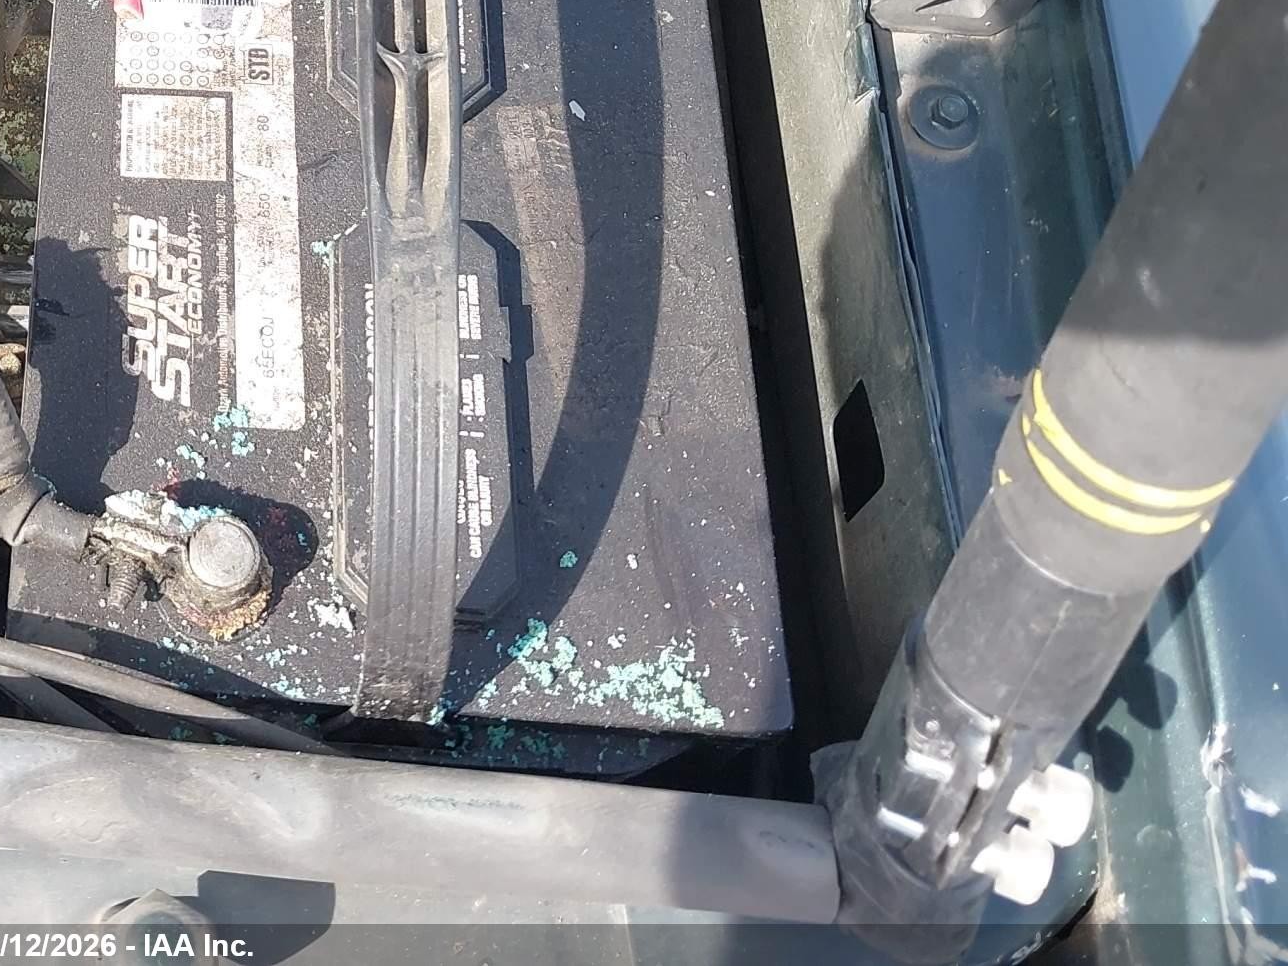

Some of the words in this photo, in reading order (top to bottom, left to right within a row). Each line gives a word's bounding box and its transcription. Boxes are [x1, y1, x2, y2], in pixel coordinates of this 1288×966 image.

[248, 48, 270, 80] STD
[257, 115, 270, 132] 80
[259, 193, 271, 218] 650
[122, 215, 157, 381] SUPER
[151, 216, 190, 407] START
[465, 448, 479, 501] BLINDNESS
[468, 502, 480, 535] CAUSE
[470, 536, 482, 558] CAN
